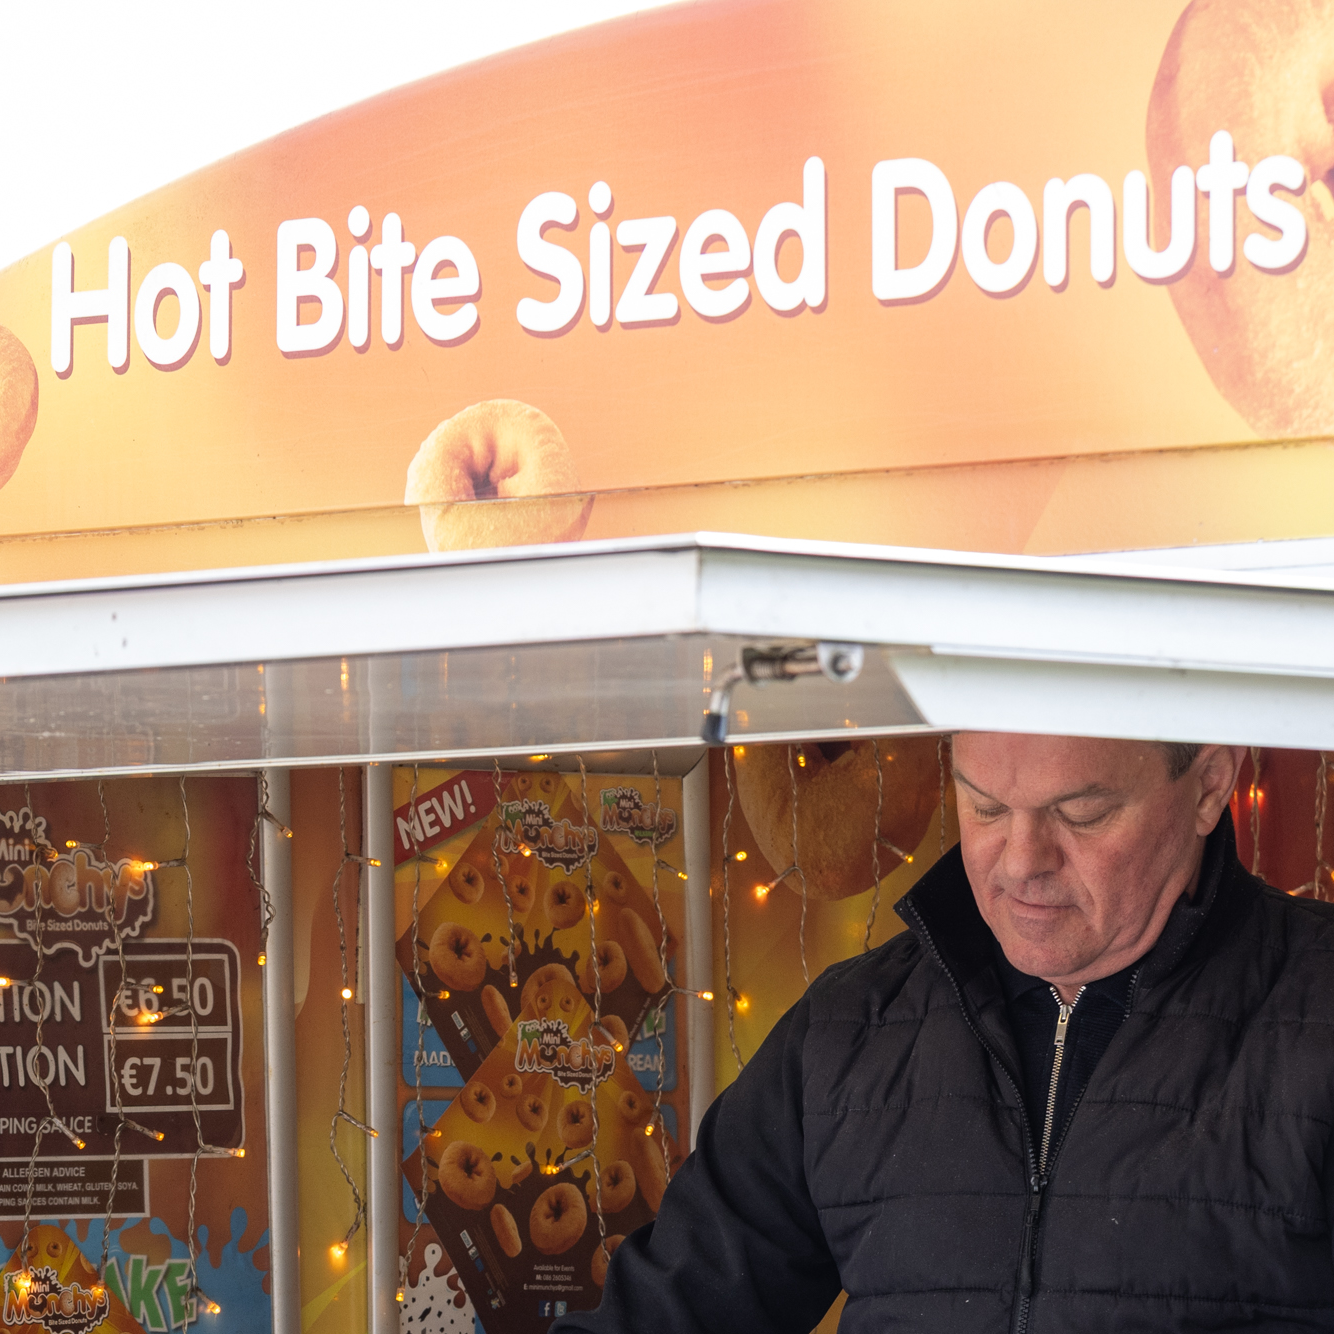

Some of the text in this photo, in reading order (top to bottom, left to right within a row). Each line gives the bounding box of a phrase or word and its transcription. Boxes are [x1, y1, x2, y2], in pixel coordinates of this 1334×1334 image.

[51, 130, 1308, 374] Hot Bite Sized Donuts
[395, 779, 476, 850] NEW!
[525, 814, 543, 825] Mini
[26, 919, 109, 931] Bie Sized Donuts
[542, 1032, 561, 1045] Mini
[627, 1054, 666, 1072] REAM
[121, 1056, 214, 1096] €7.50
[2, 1167, 86, 1178] ALLERGEN ADVICE
[48, 1197, 80, 1206] CONTAIN
[30, 1279, 50, 1293] Mini
